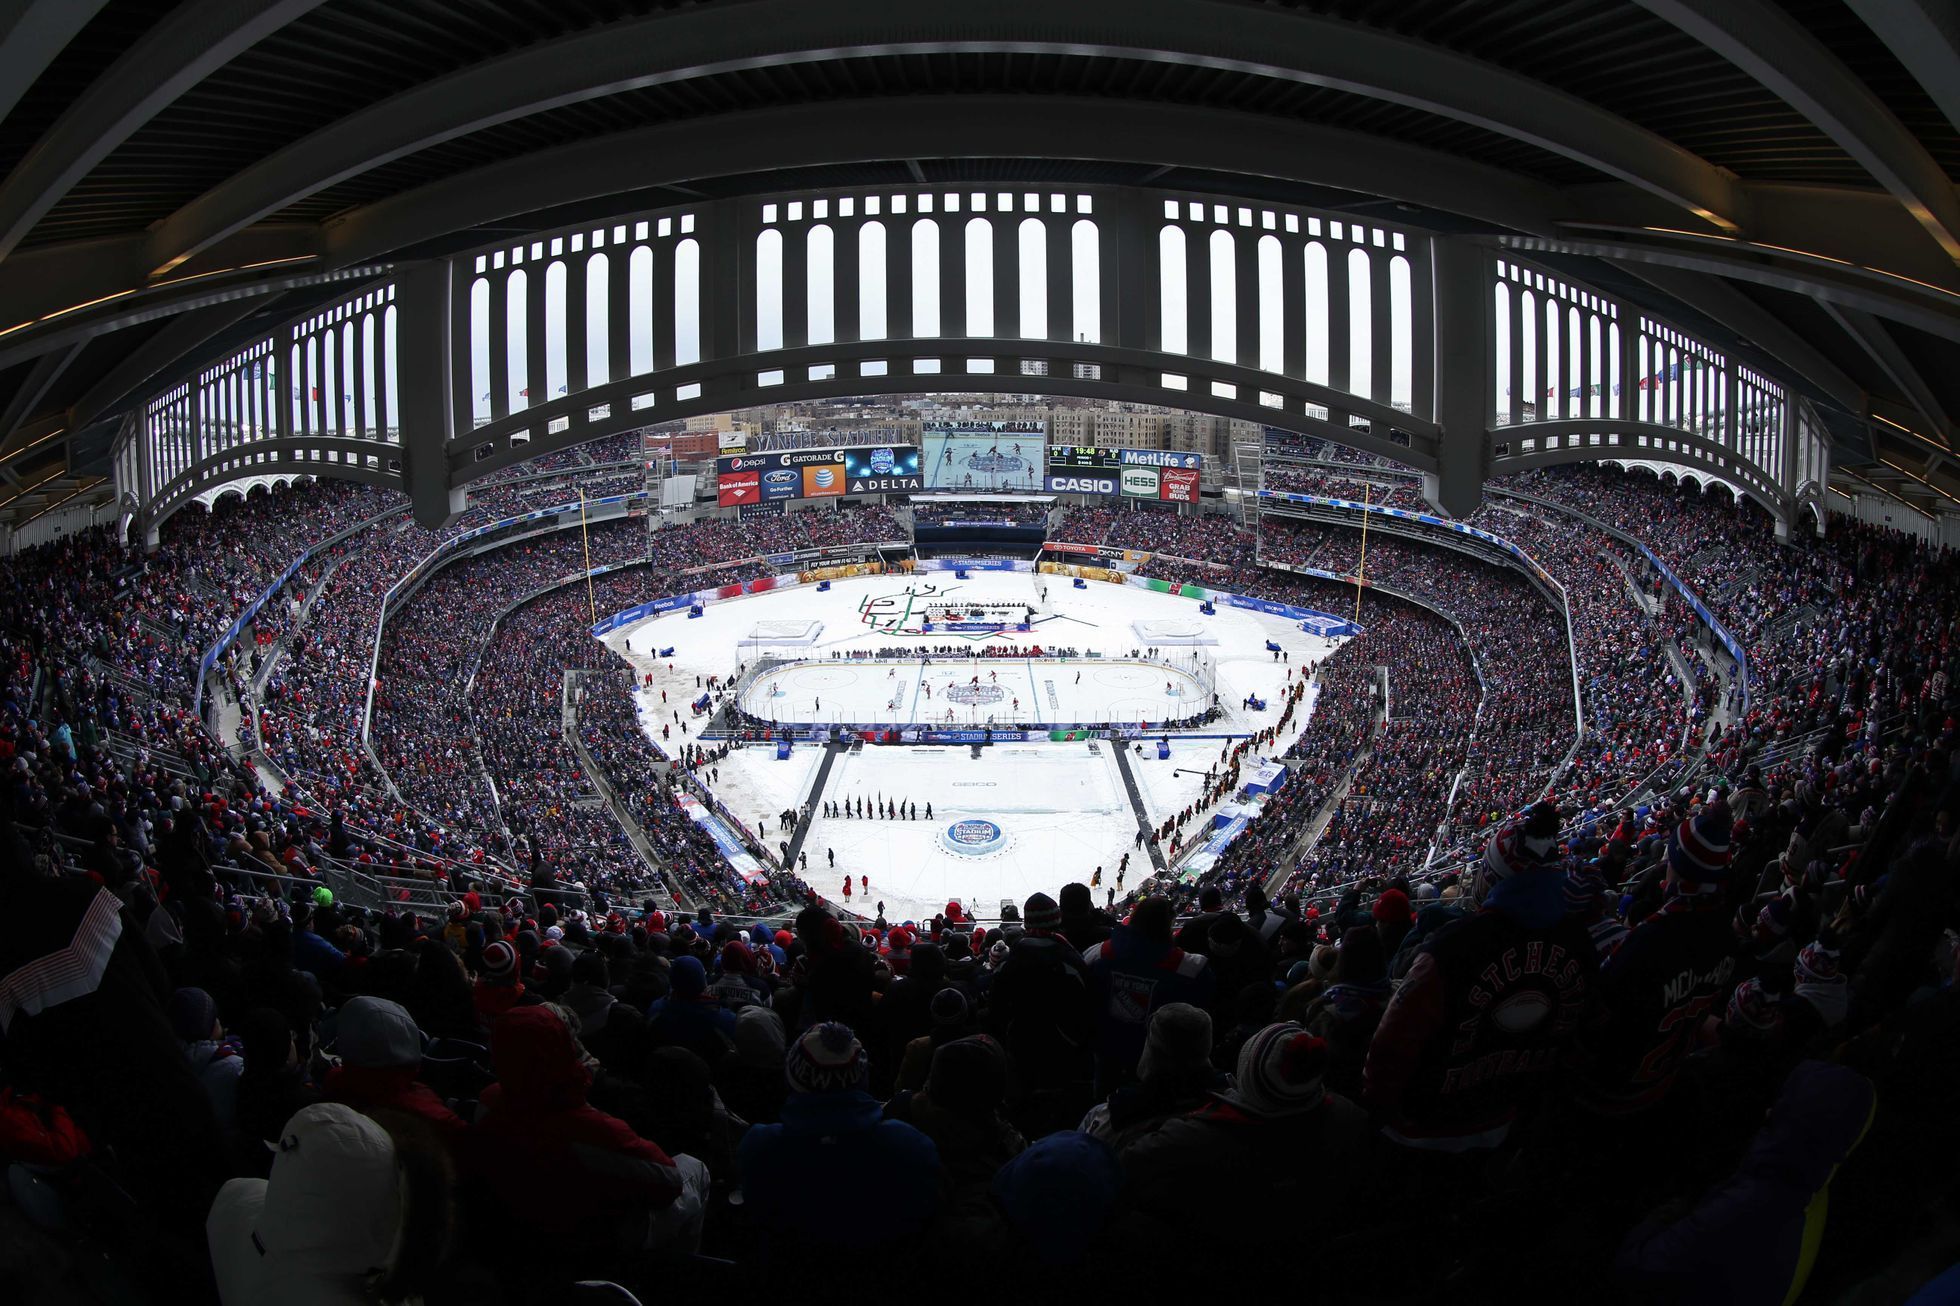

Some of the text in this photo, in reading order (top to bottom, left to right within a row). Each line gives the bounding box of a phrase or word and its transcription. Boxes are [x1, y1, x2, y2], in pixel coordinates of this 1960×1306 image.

[755, 428, 902, 452] YANKEE STADIUM
[1076, 447, 1095, 455] 19:48
[793, 454, 832, 464] GATORADE
[1125, 451, 1179, 467] MetLife
[743, 458, 766, 470] pepsi
[770, 473, 791, 482] Ford
[1124, 476, 1156, 488] HESS
[738, 480, 758, 488] America
[869, 479, 919, 490] DELTA
[1051, 477, 1113, 493] CASIO
[1169, 483, 1190, 491] GRAB
[1169, 493, 1190, 501] BUDS
[1098, 550, 1124, 558] DKNY
[819, 559, 831, 567] YOUR
[654, 600, 675, 610] Reebok
[992, 732, 1021, 740] SERIES
[956, 828, 993, 836] STADIUM
